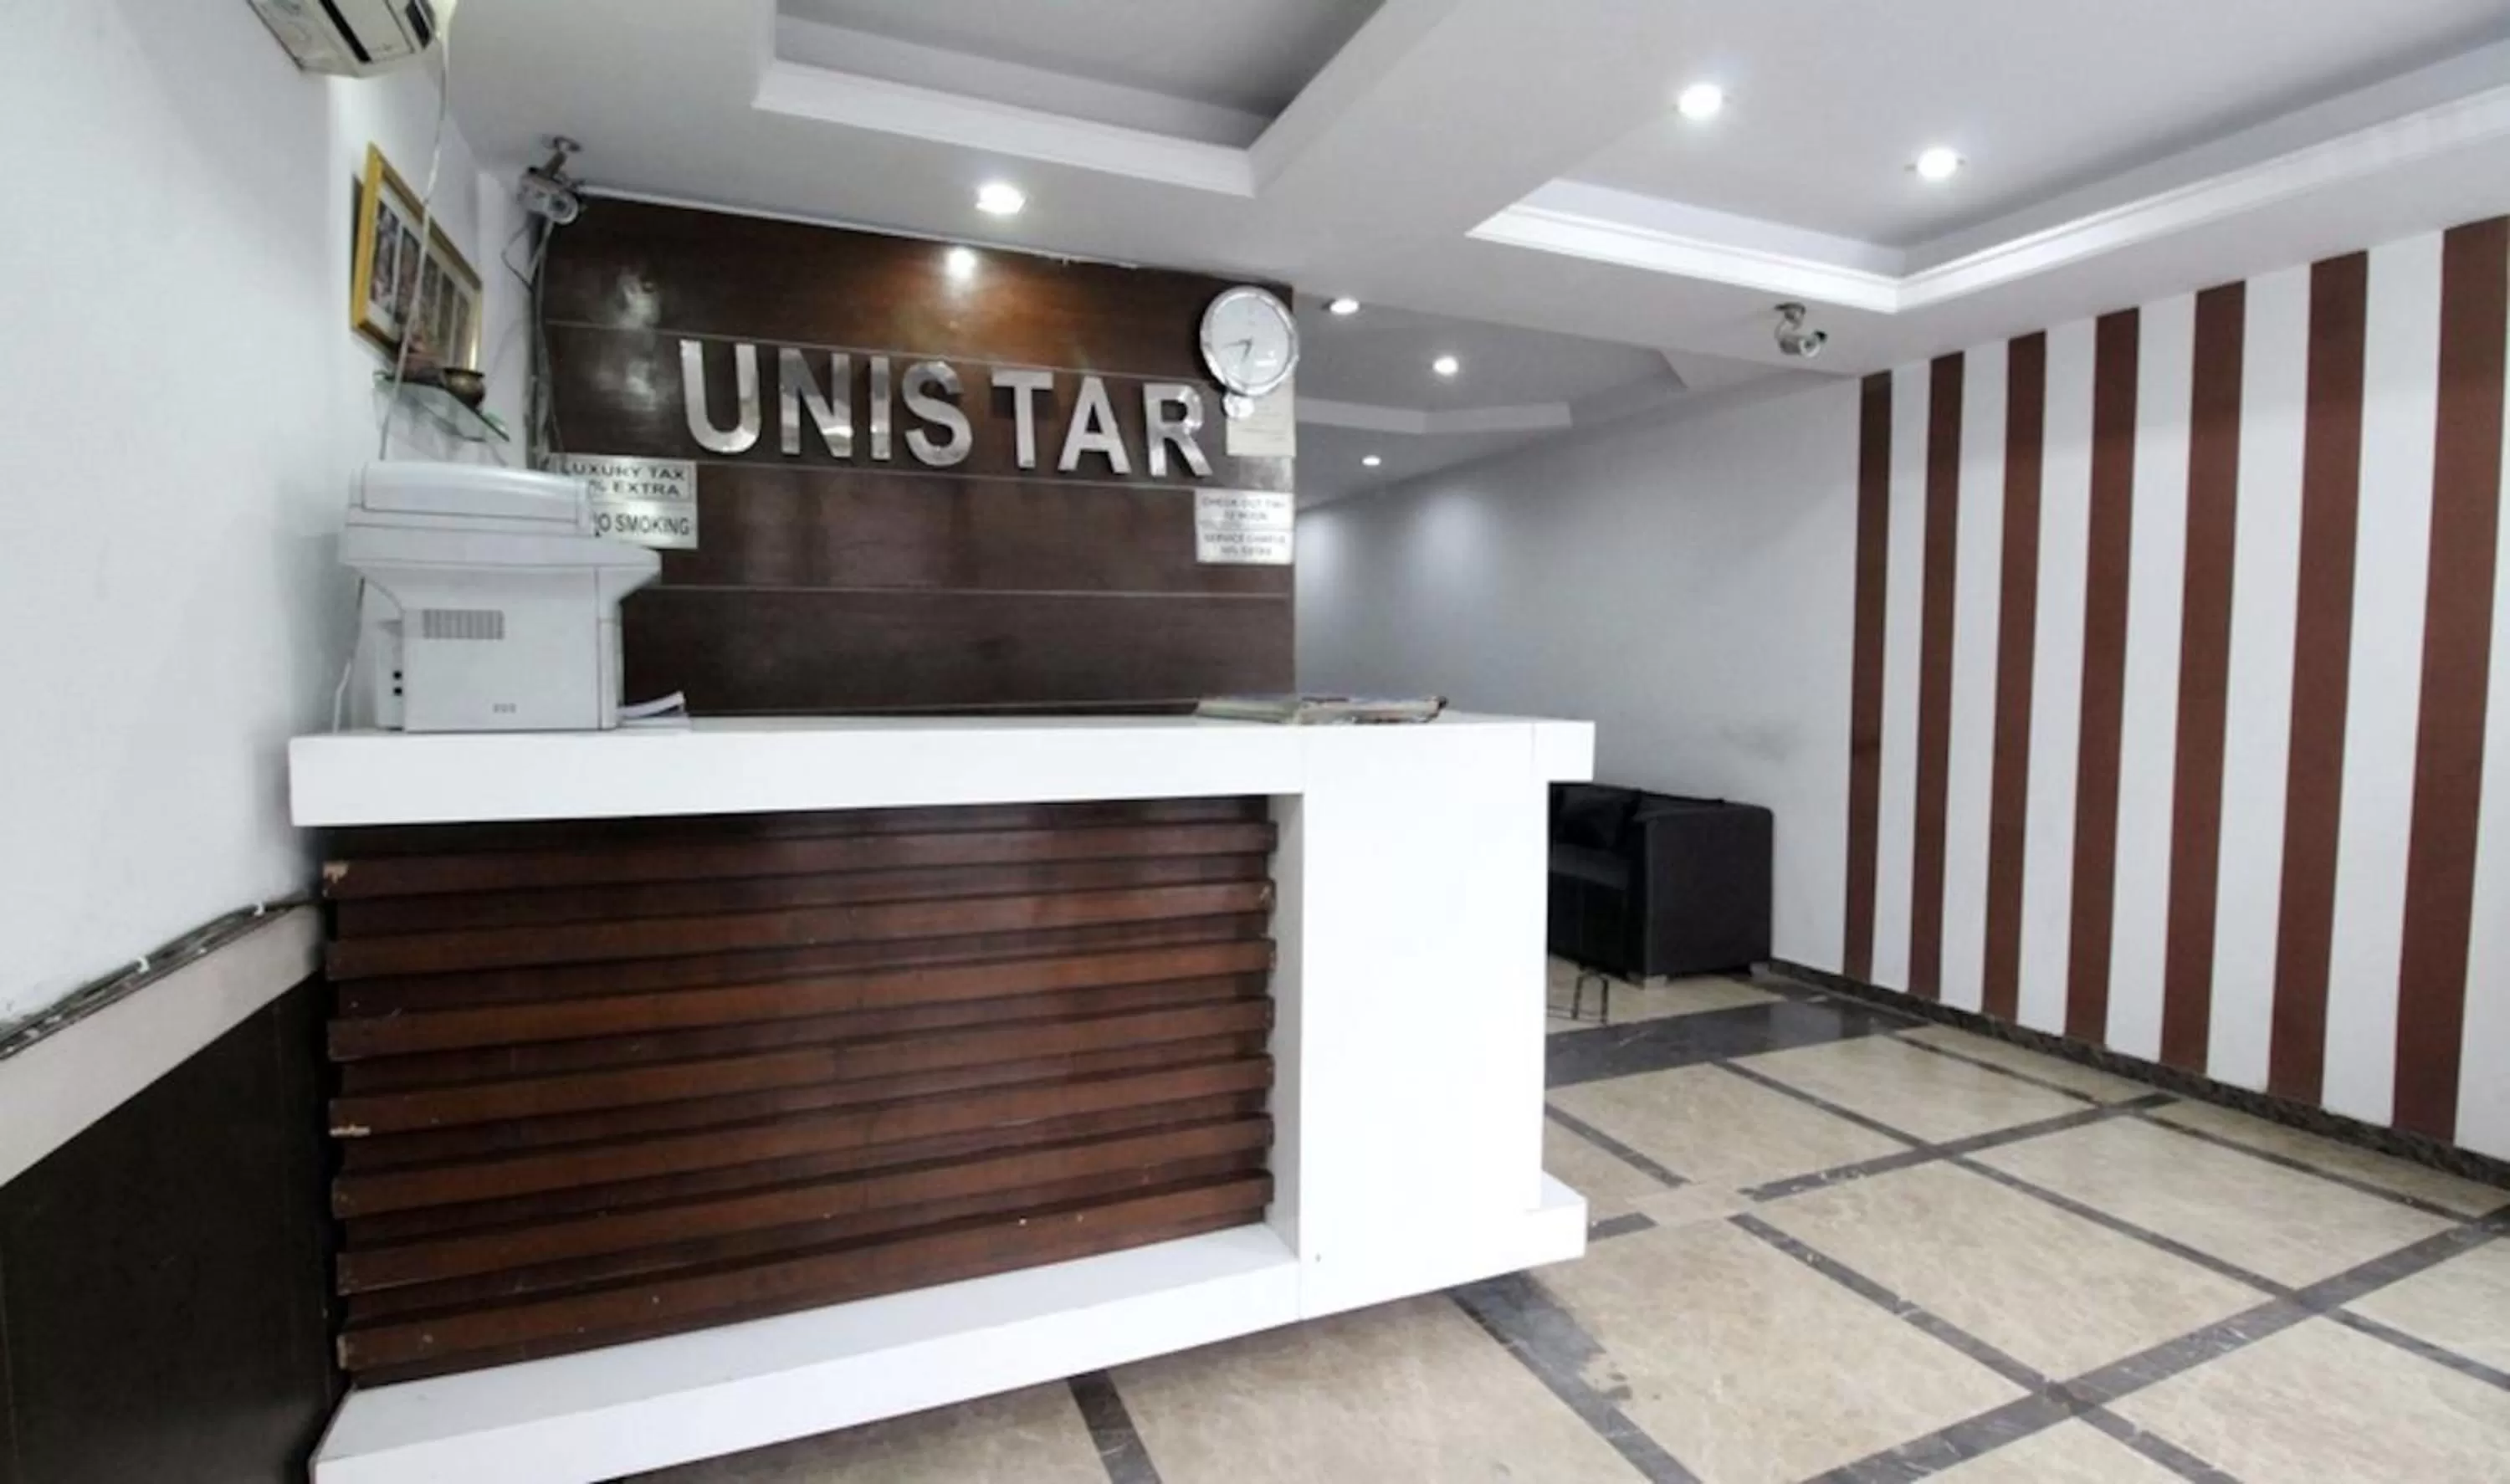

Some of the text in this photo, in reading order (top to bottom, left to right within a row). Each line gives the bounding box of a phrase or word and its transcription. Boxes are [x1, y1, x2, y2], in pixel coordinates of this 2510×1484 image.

[679, 339, 1213, 478] UNISTAR
[560, 463, 685, 481] LUXURY TAX
[612, 480, 681, 498] EXTRA
[614, 513, 690, 536] SMOKING
